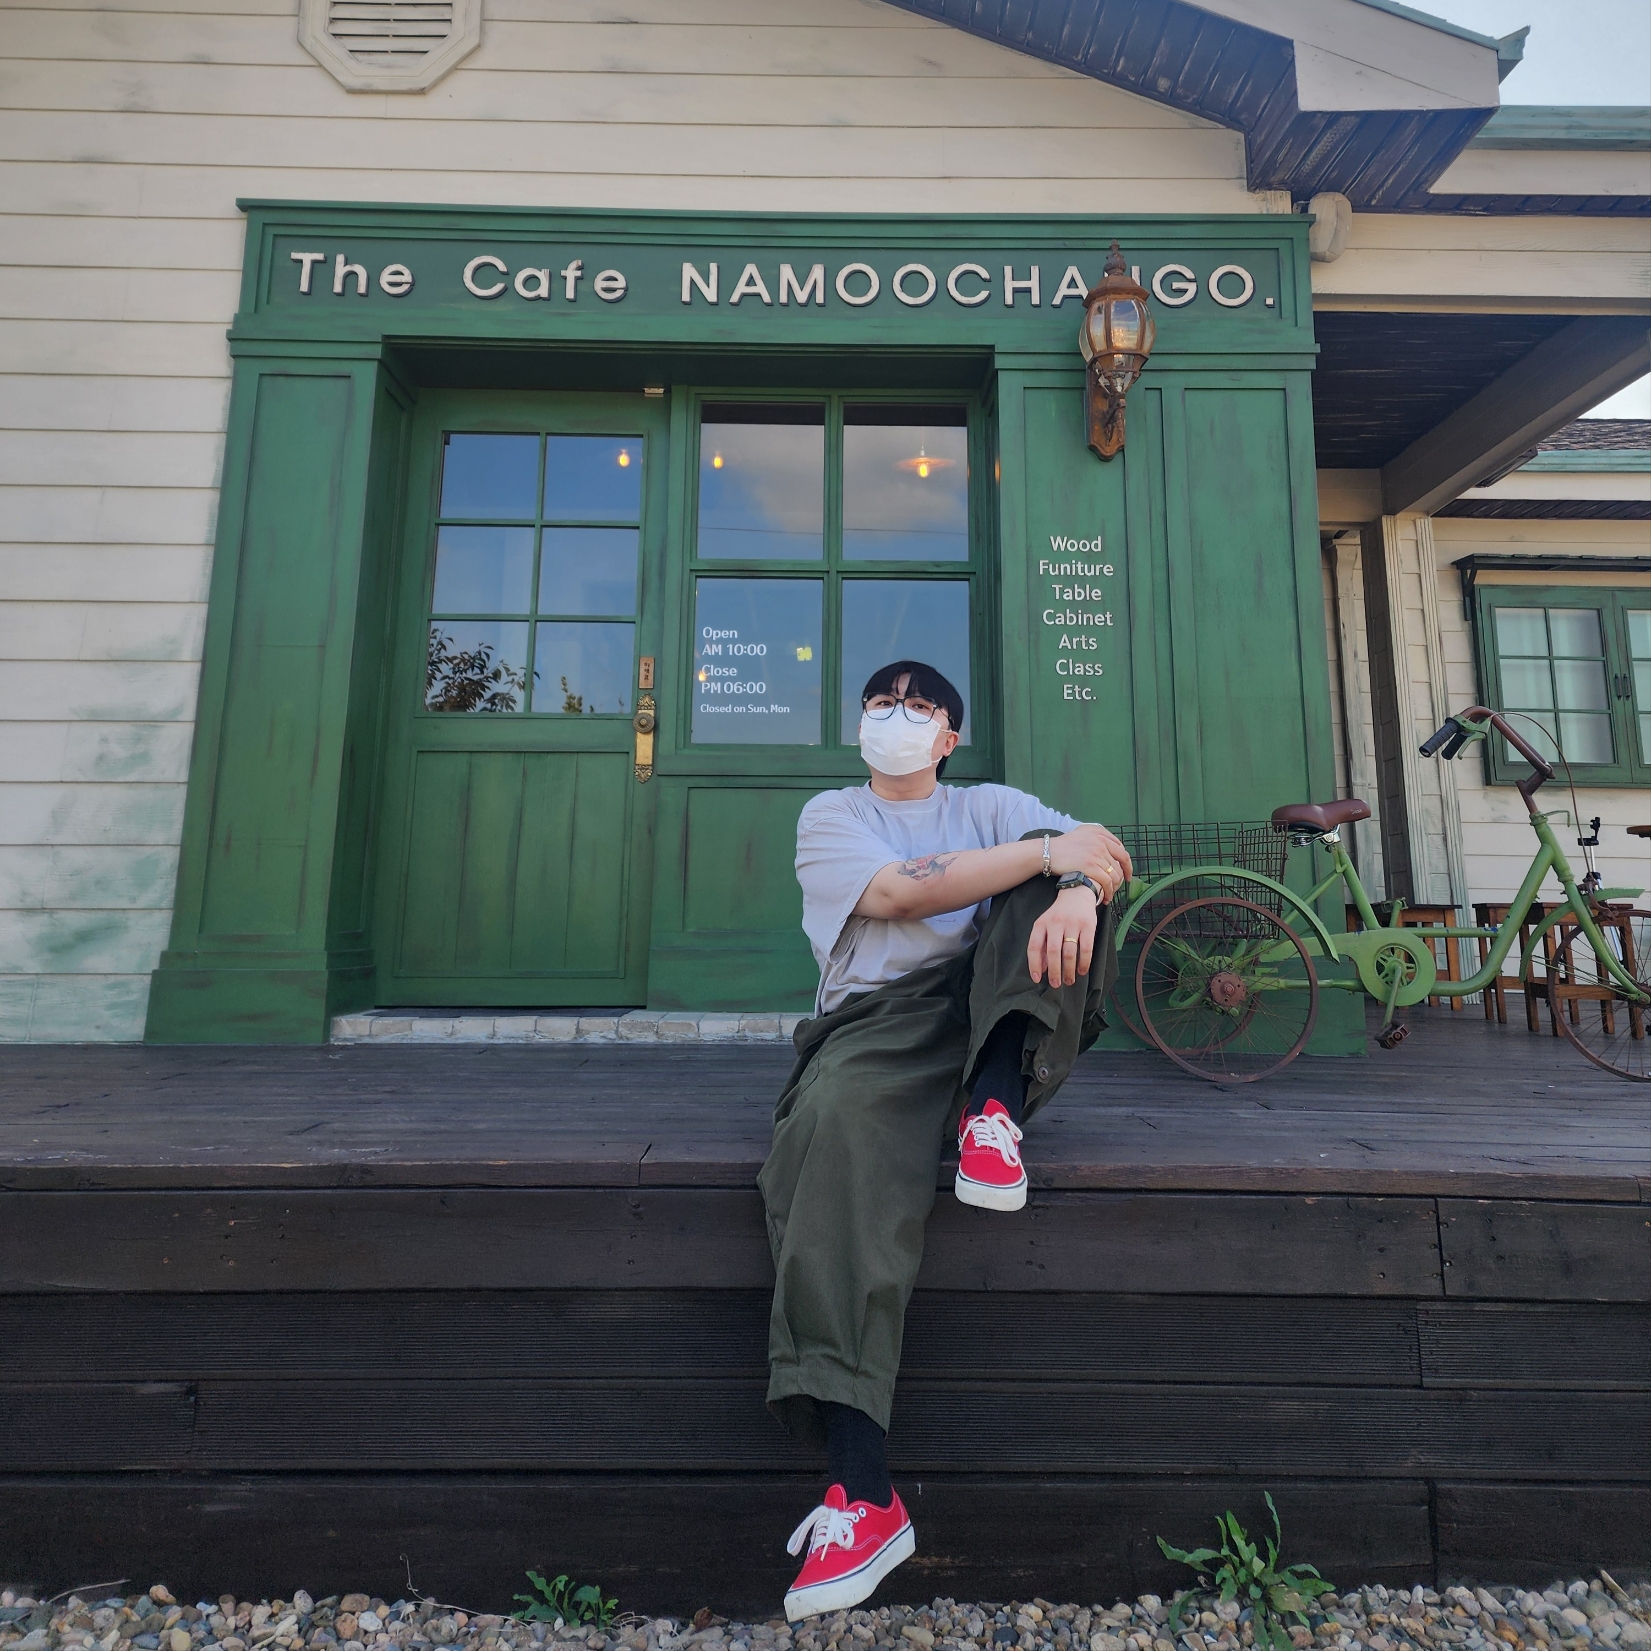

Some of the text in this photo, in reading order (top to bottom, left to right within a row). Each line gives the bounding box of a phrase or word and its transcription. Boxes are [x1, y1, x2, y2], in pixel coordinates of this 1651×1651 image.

[290, 252, 1275, 308] The Cafe NAMOOCHAGO.
[1050, 536, 1102, 552] Wood
[1039, 560, 1114, 577] Funiture
[1052, 584, 1102, 601] Table
[1042, 609, 1114, 626] Cabinet
[702, 627, 738, 640] Open
[701, 644, 767, 656] AM 10:00
[1058, 634, 1098, 650] Arts
[701, 665, 737, 676] Close
[1055, 659, 1103, 676] Class
[701, 682, 766, 694] PM 06:00
[1063, 684, 1096, 700] Etc.
[700, 704, 731, 713] Closed
[748, 704, 768, 714] Sun,
[771, 704, 790, 713] Mon
